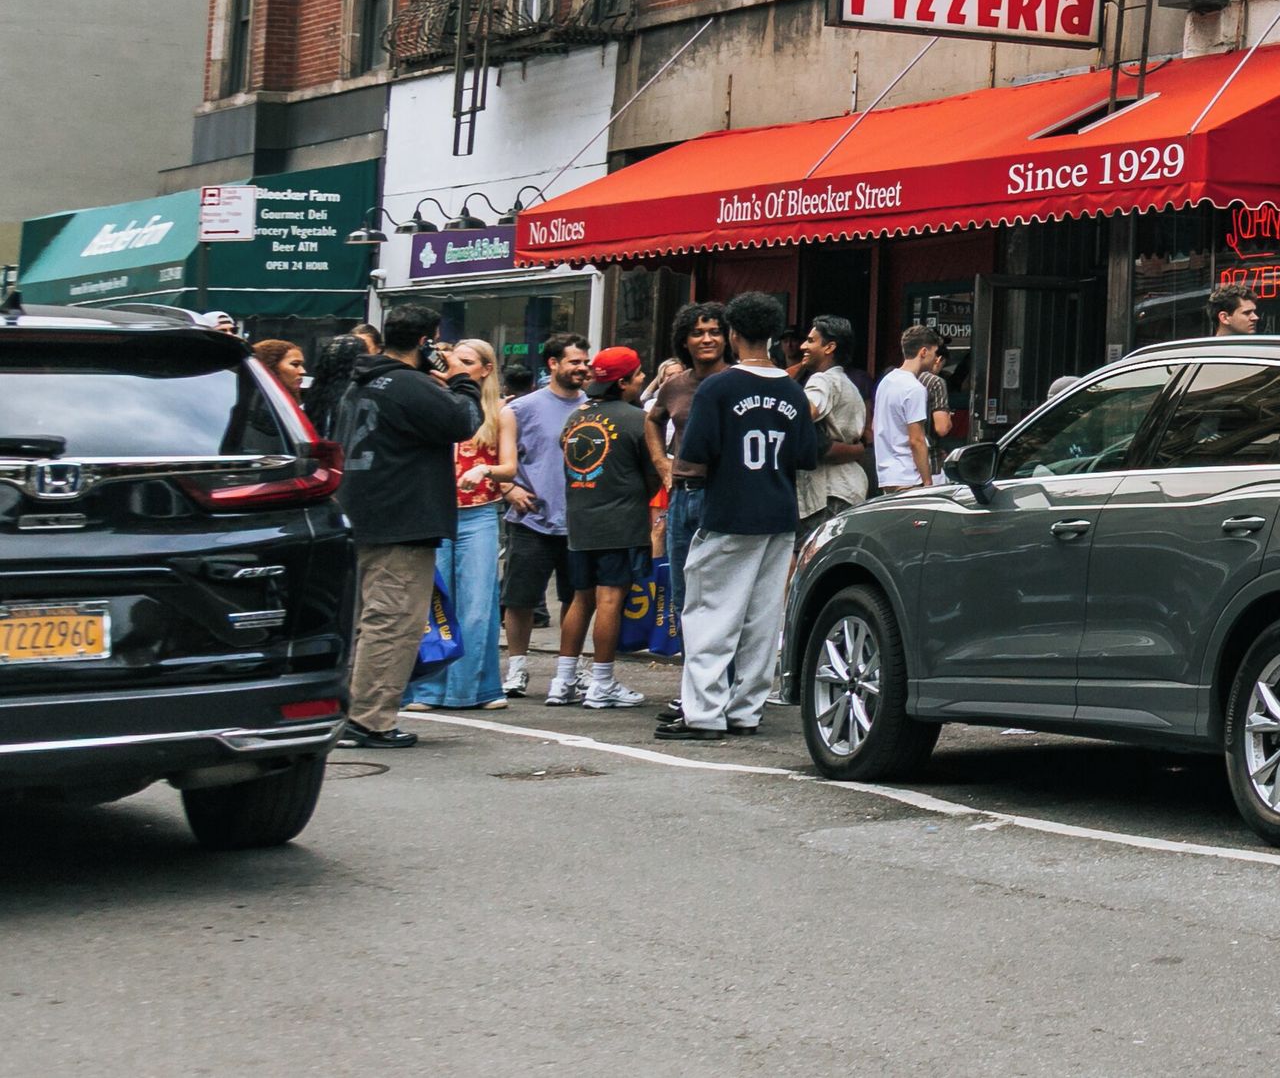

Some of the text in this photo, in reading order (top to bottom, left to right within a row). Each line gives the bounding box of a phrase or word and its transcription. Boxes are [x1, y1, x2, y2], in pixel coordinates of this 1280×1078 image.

[1007, 143, 1185, 196] Since 1929
[308, 190, 341, 202] Farm
[716, 179, 902, 225] John's Of Bleecker Street
[261, 209, 328, 220] Gourmet Deli
[291, 225, 337, 239] Vegetable
[528, 218, 586, 245] No Slices
[272, 242, 318, 252] Beer ATM
[266, 261, 329, 271] OPEN 24 HOUR
[733, 395, 798, 420] CHILD OF GOD
[743, 429, 786, 470] 07
